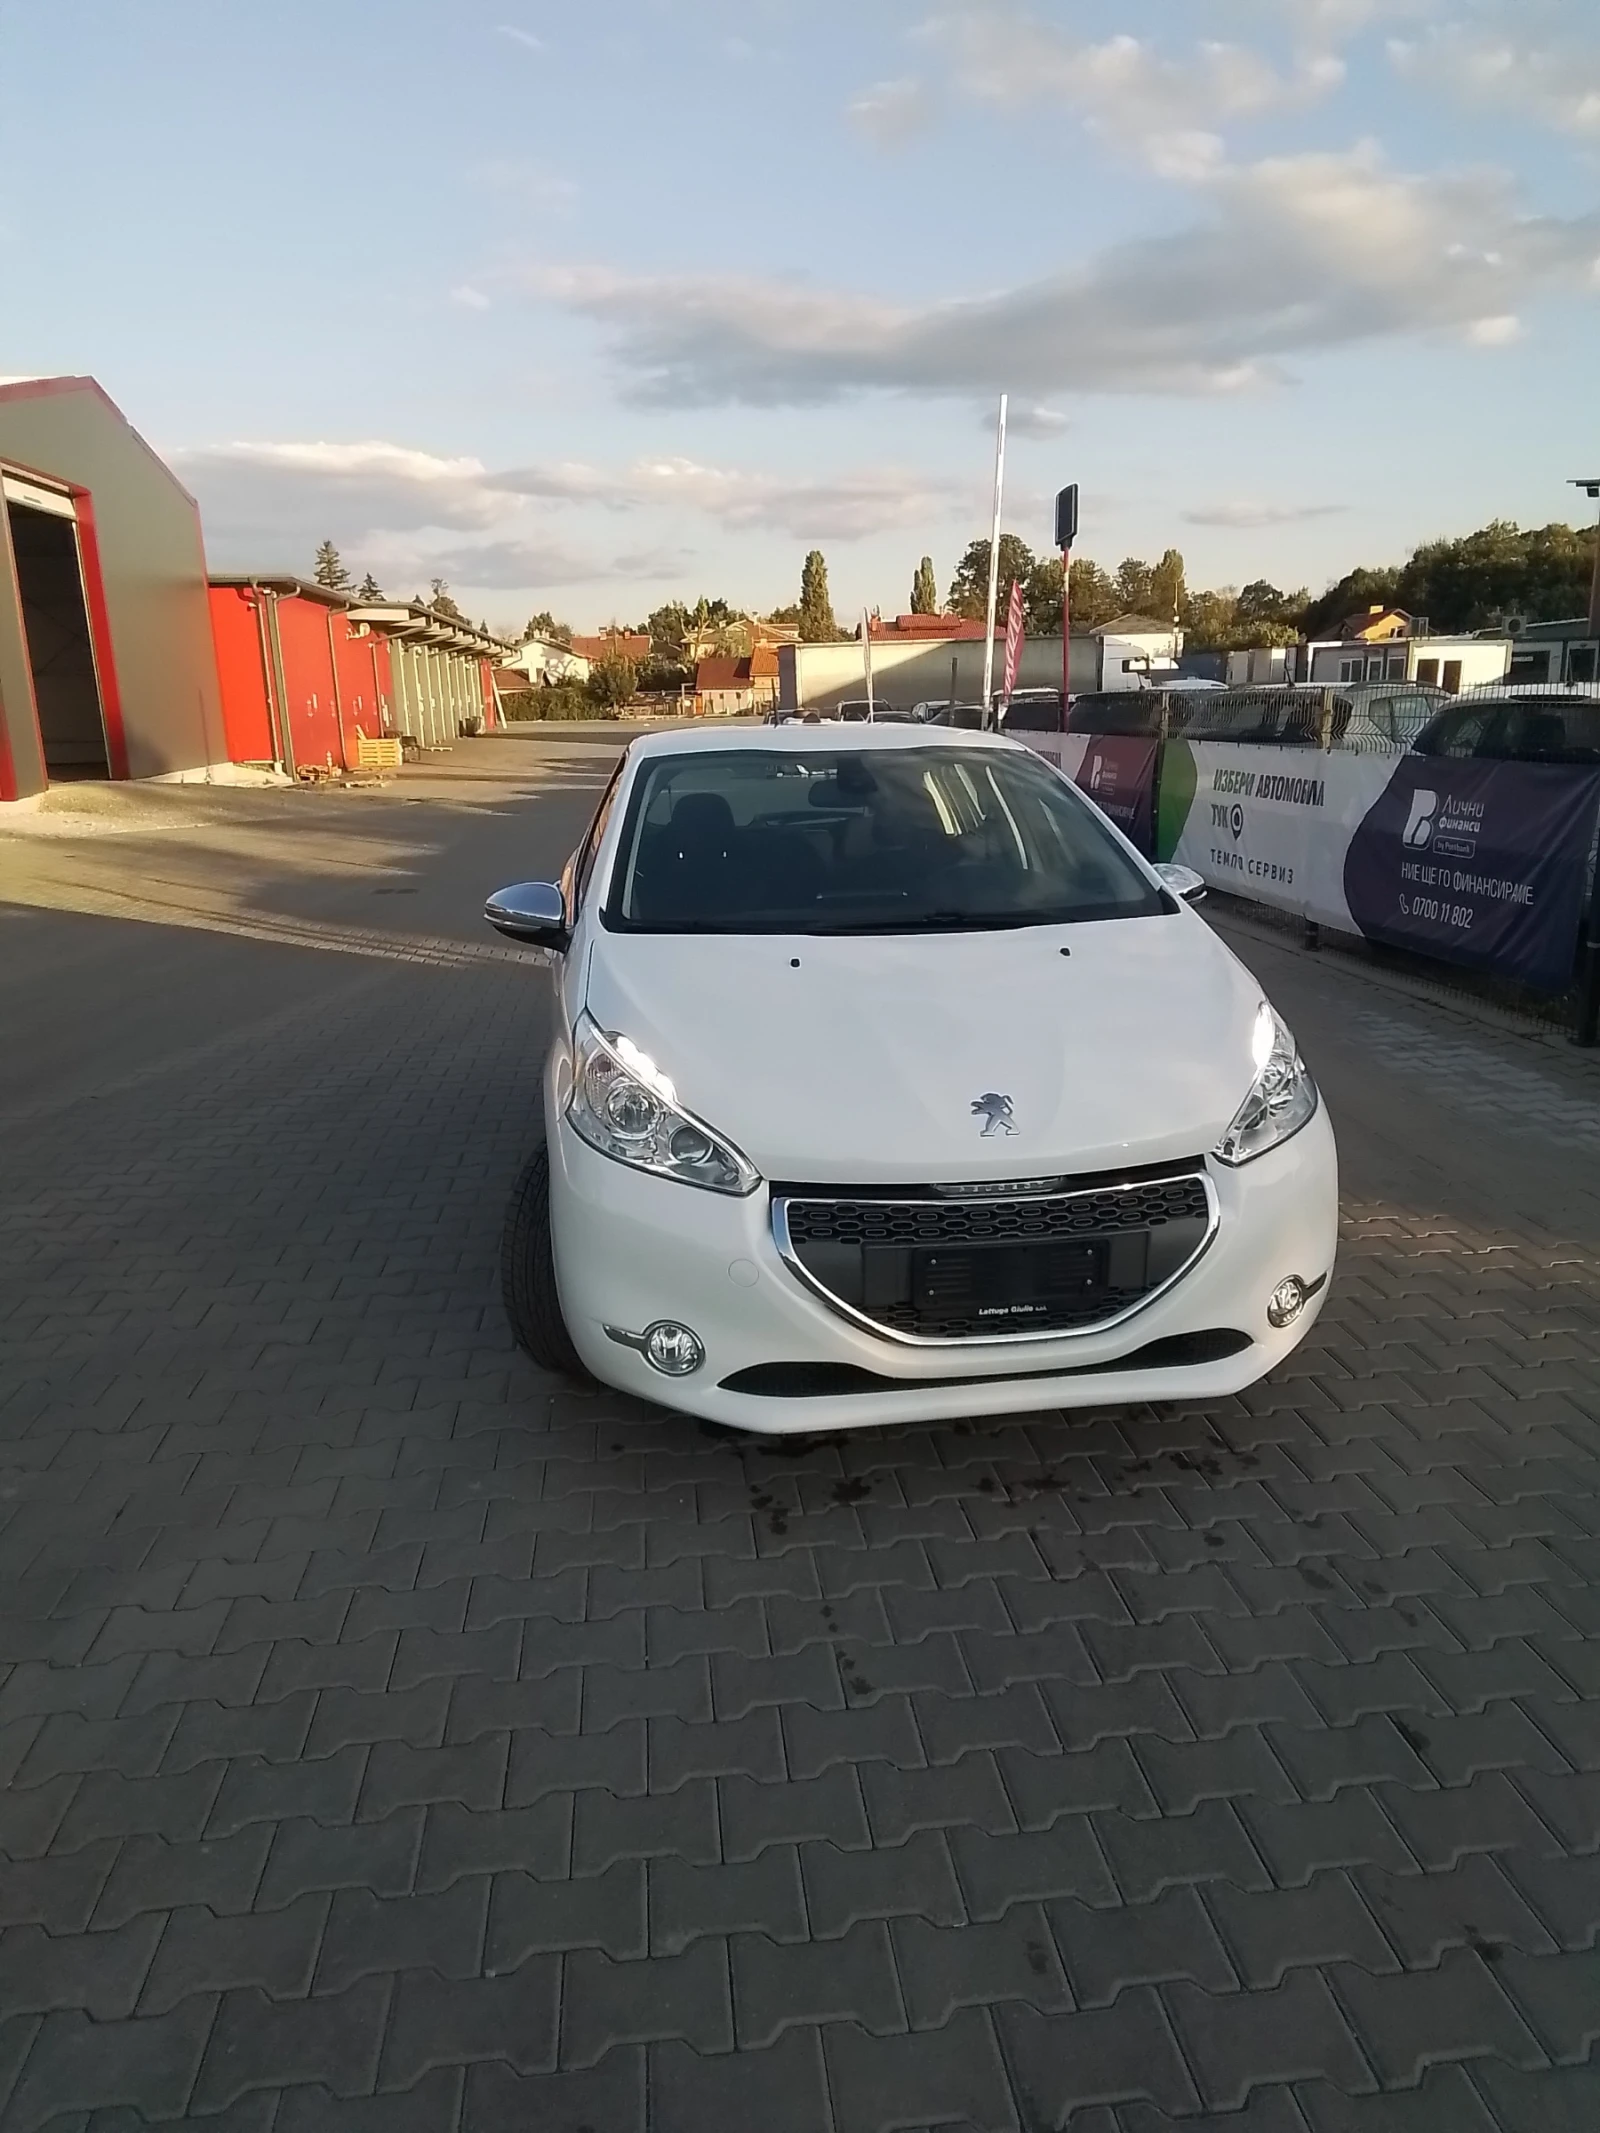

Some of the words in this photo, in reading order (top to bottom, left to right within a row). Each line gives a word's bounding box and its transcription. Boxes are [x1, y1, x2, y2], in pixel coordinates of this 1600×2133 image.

[1212, 768, 1256, 797] ИЗБЕРИ
[1255, 774, 1326, 807] АВТОМОБИЛ
[1210, 803, 1229, 829] ТУК
[1441, 794, 1485, 818] Лични
[1210, 848, 1244, 871] ТЕМПО
[1248, 859, 1294, 884] СЕРВИЗ
[1401, 861, 1421, 881] НИЕ
[1421, 865, 1437, 885] ЩЕ
[1438, 868, 1451, 888] ГО
[1453, 870, 1535, 905] ФИНАНСИРАМЕ
[1412, 896, 1439, 920] 0700
[1440, 902, 1451, 923] 11
[1451, 905, 1474, 929] 802
